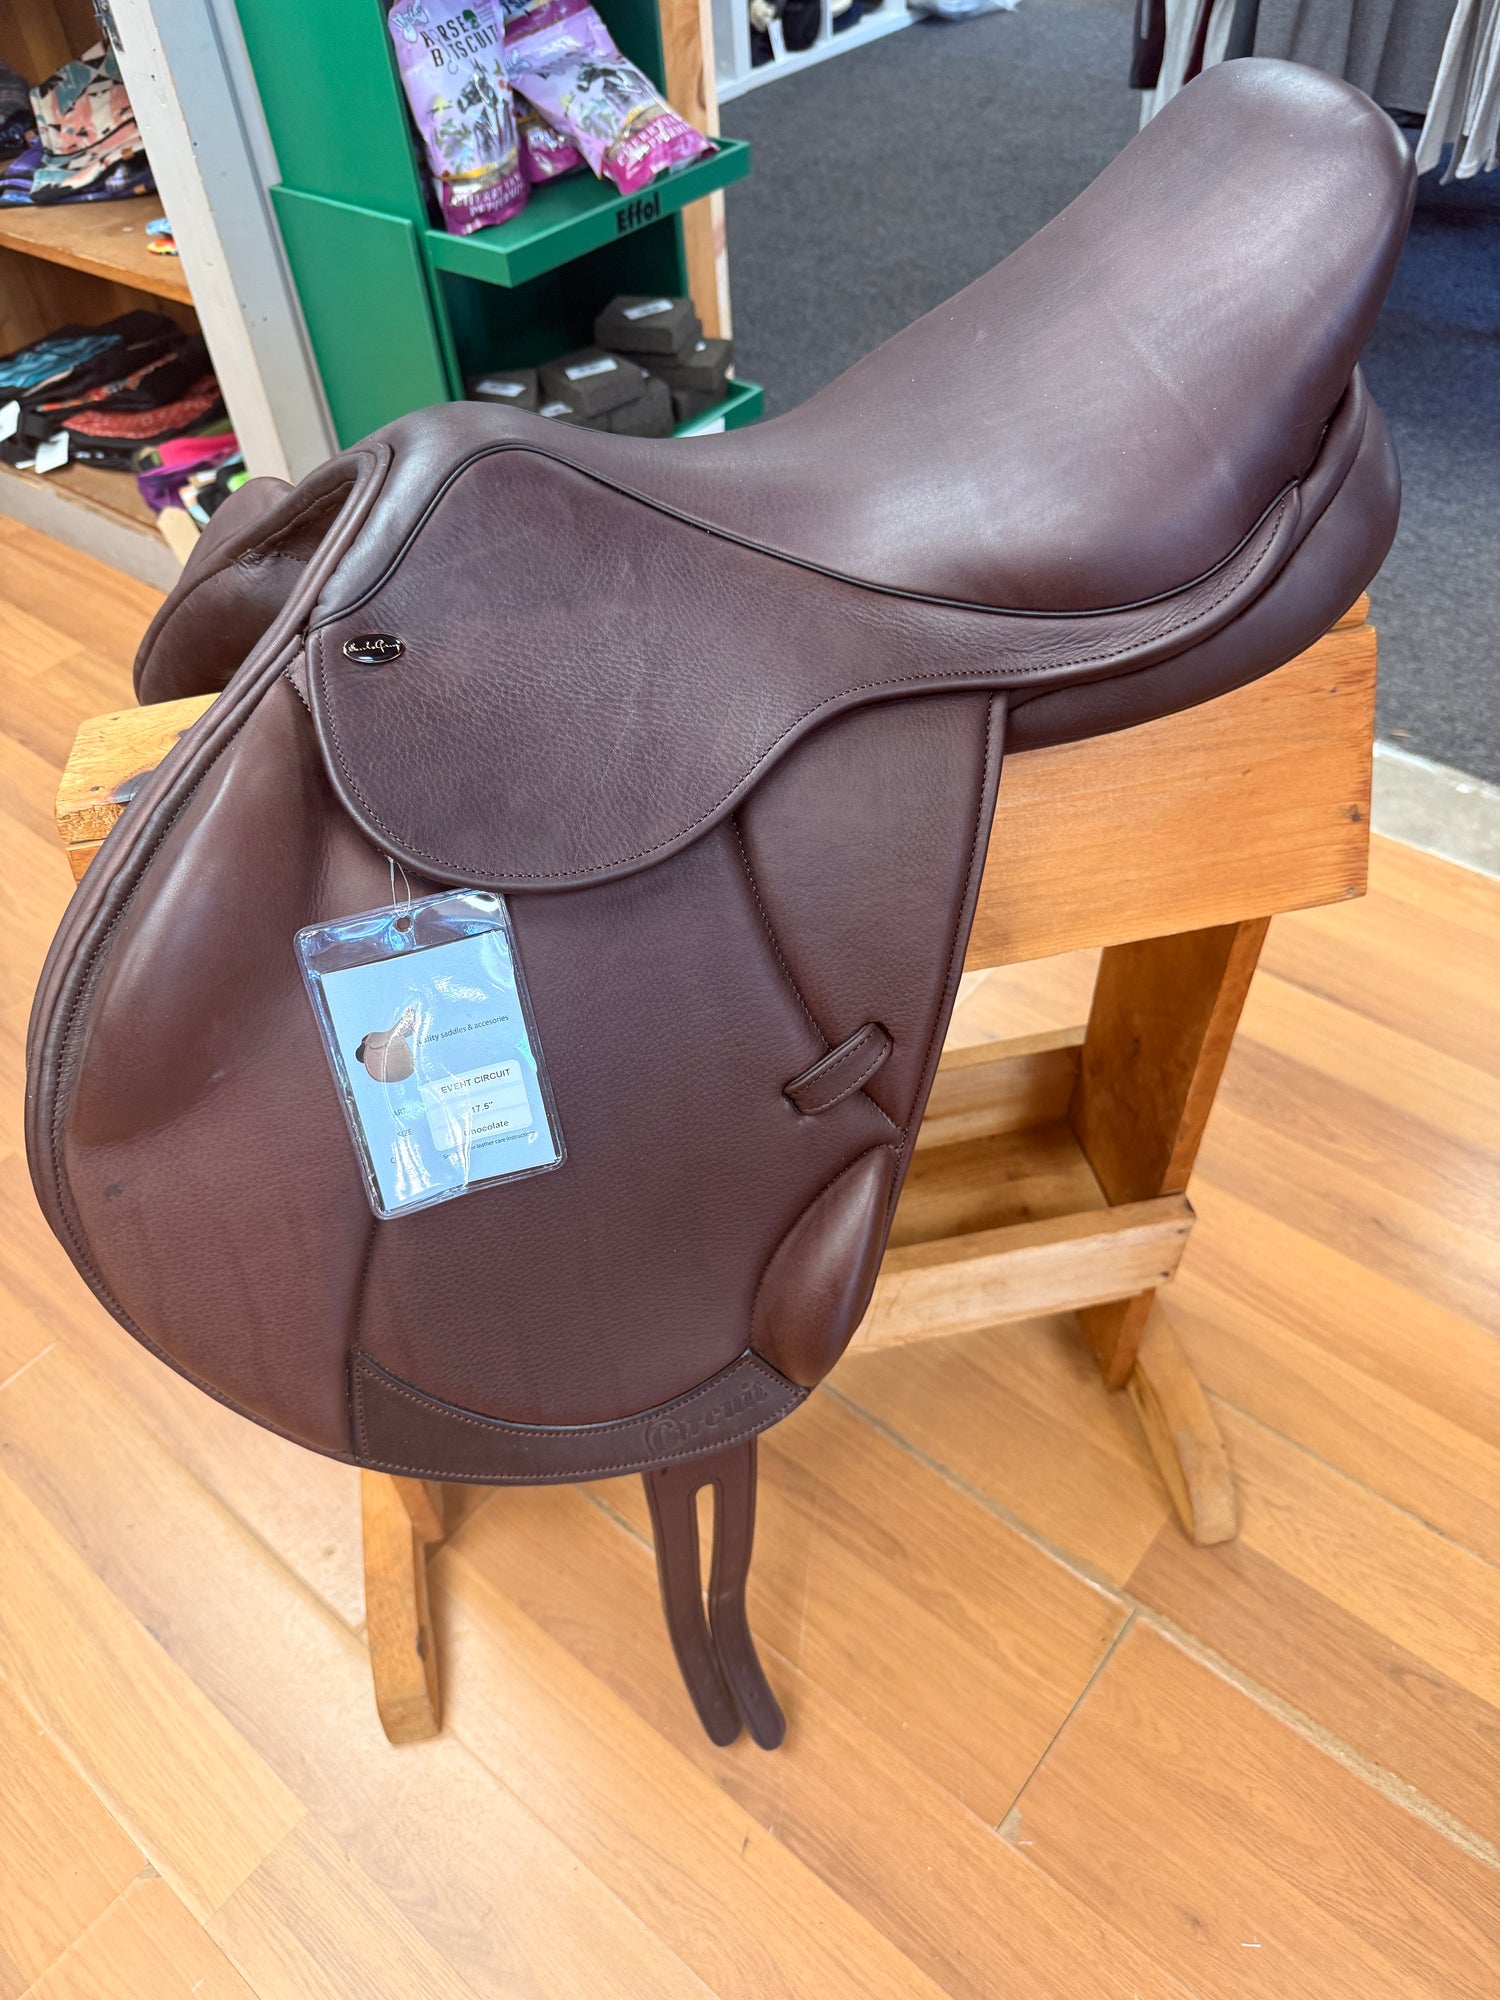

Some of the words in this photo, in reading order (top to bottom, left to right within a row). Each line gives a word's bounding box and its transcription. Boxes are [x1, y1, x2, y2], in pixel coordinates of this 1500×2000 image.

[617, 192, 659, 232] Effol
[440, 1026, 467, 1039] saddles
[467, 1023, 473, 1031] &
[440, 1079, 471, 1094] EVENT
[474, 1068, 511, 1084] CIRCUIT
